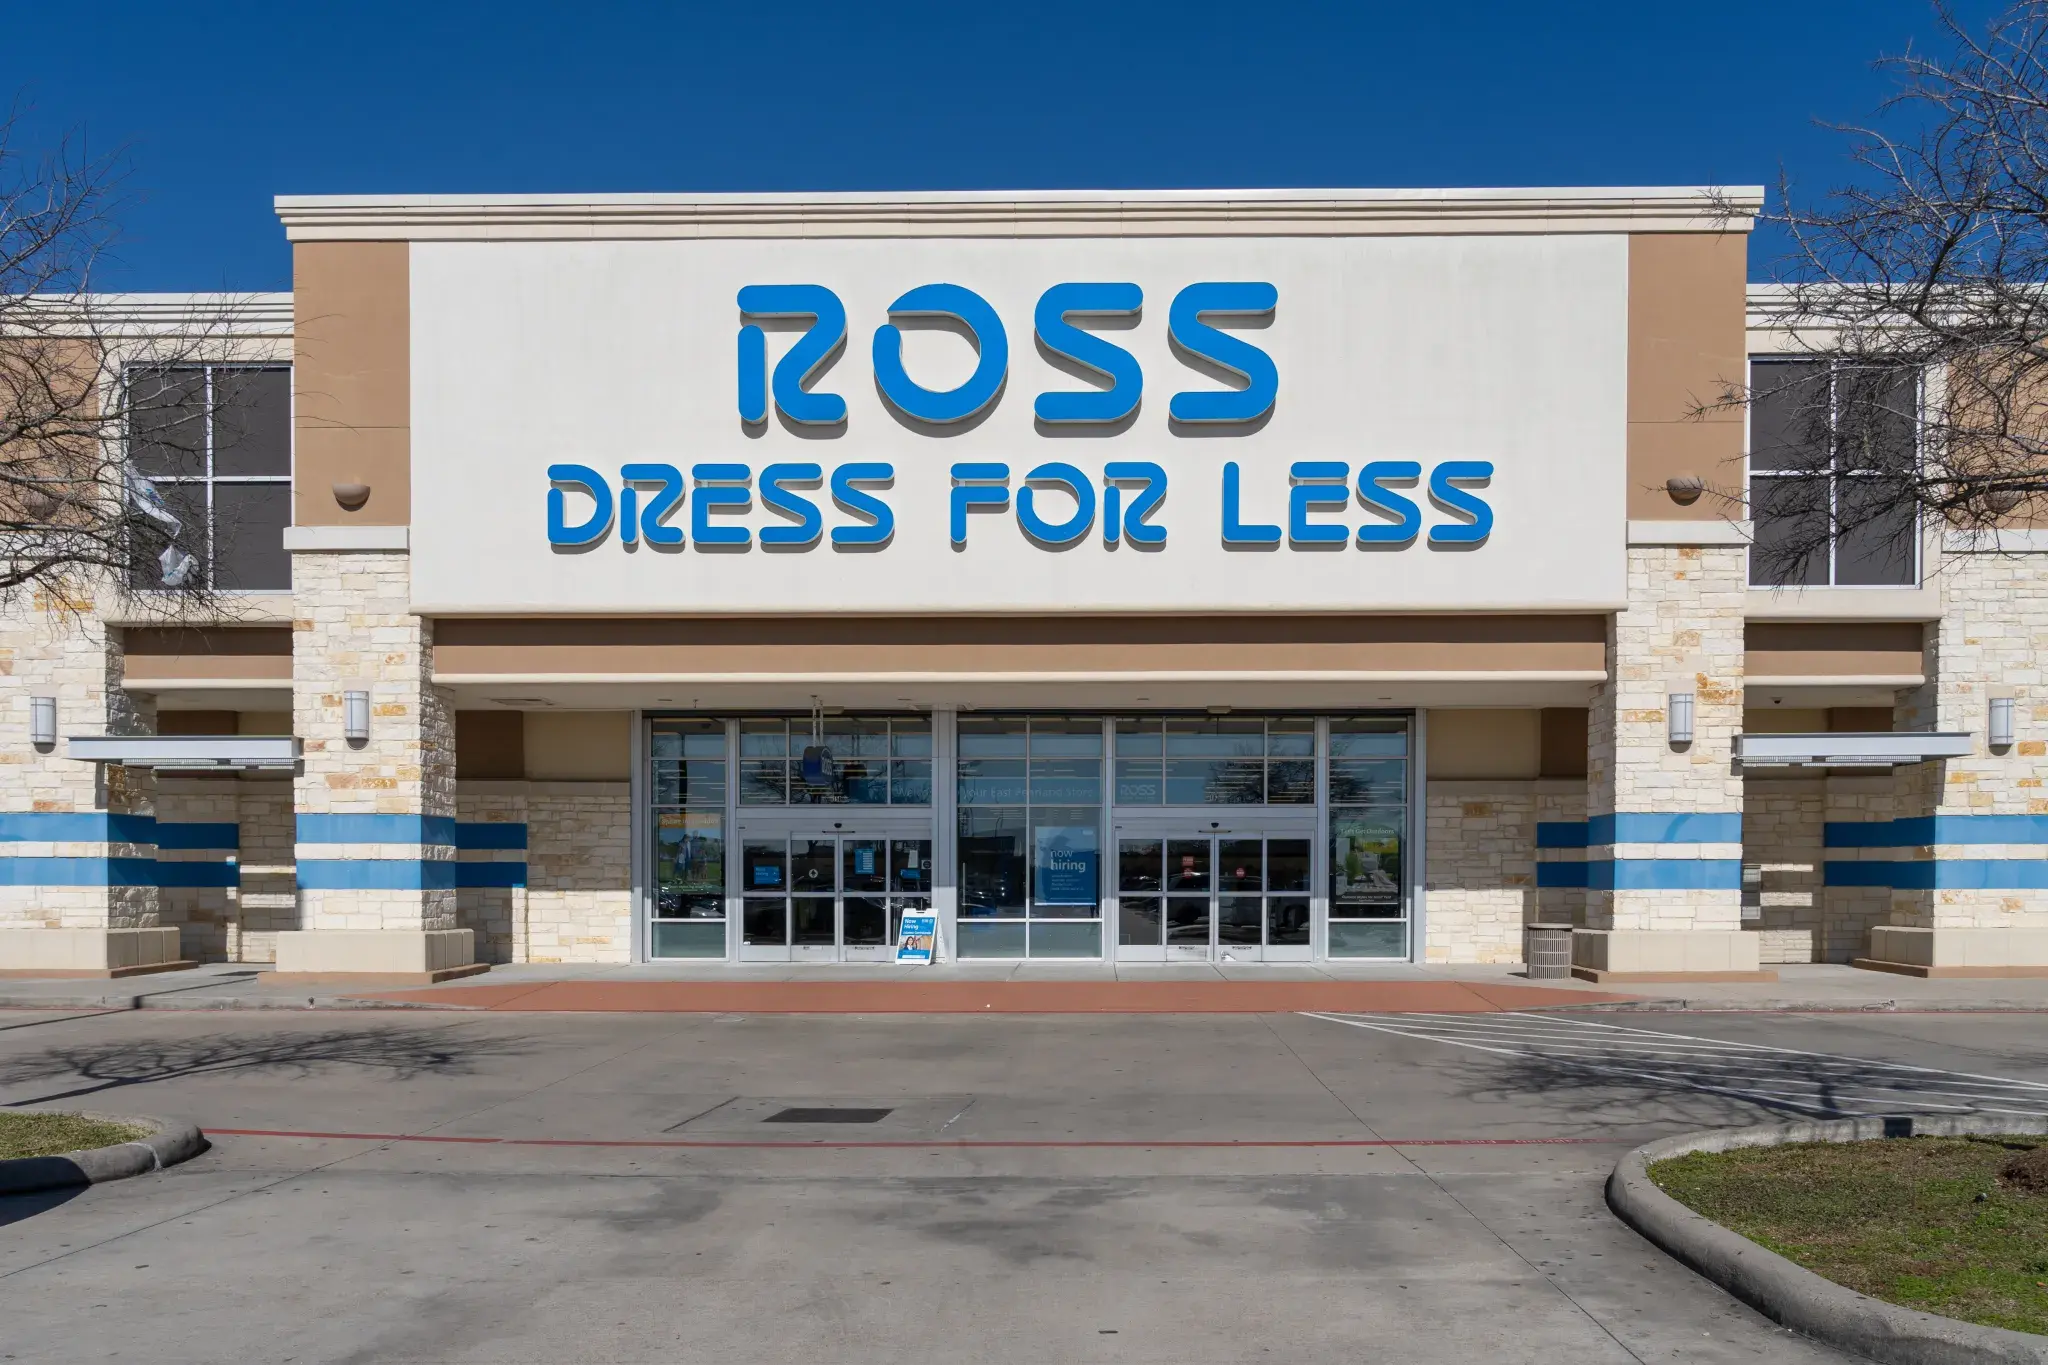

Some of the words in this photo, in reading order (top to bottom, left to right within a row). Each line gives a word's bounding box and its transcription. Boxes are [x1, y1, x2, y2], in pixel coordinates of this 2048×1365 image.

[736, 282, 1279, 423] ROSS
[548, 463, 893, 545] DRESS
[951, 462, 1168, 544] FOR
[1223, 461, 1493, 544] LESS
[963, 788, 988, 800] your
[991, 786, 1012, 798] East
[1120, 784, 1156, 796] ROSS
[1050, 850, 1074, 858] now
[1050, 858, 1087, 874] hiring
